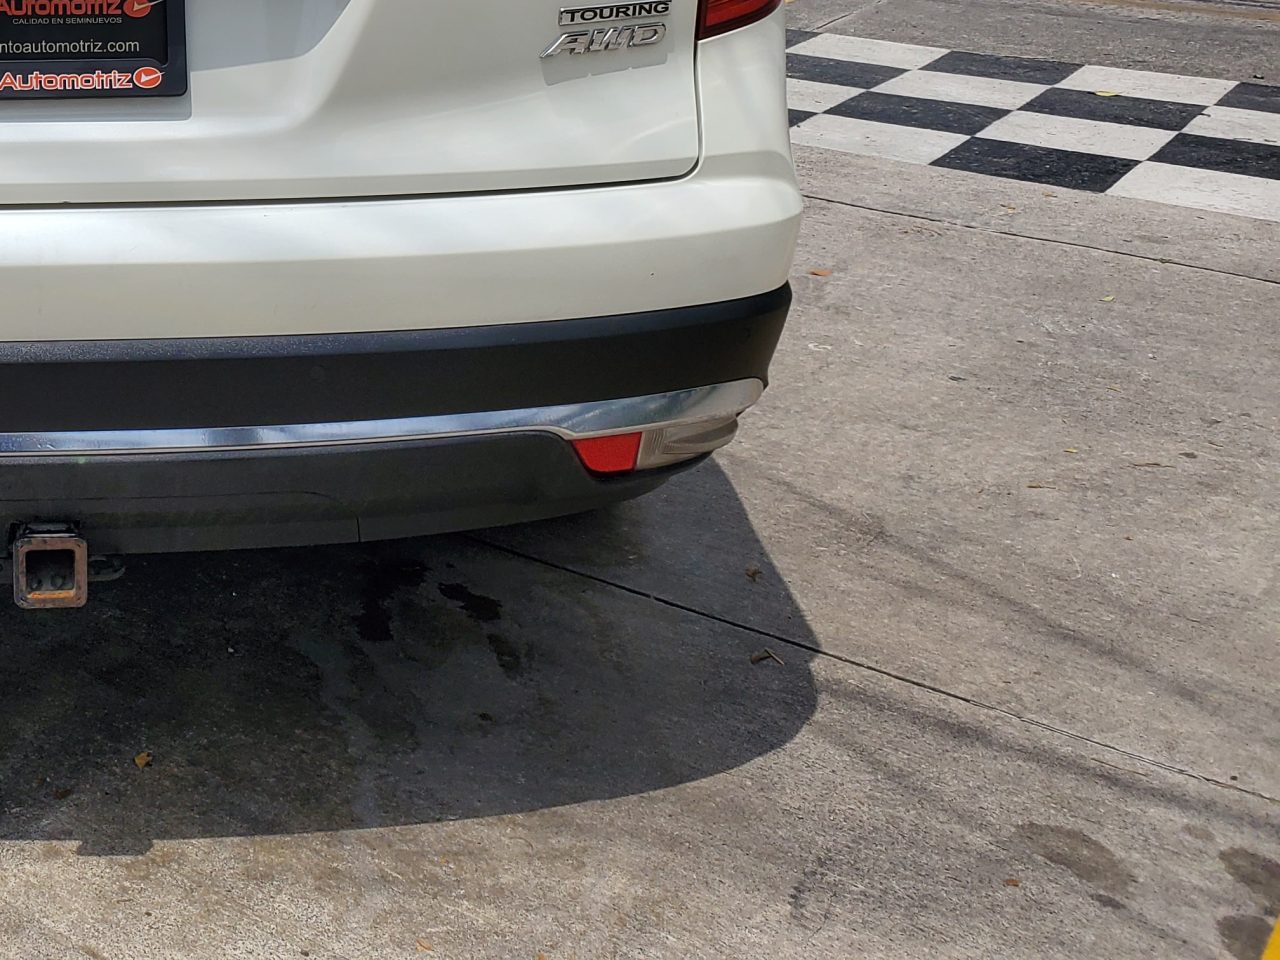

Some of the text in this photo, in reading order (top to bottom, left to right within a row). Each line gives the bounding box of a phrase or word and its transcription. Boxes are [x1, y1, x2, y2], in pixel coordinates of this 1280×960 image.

[51, 17, 64, 25] EN
[566, 2, 670, 23] TOURING
[539, 22, 667, 58] AWD
